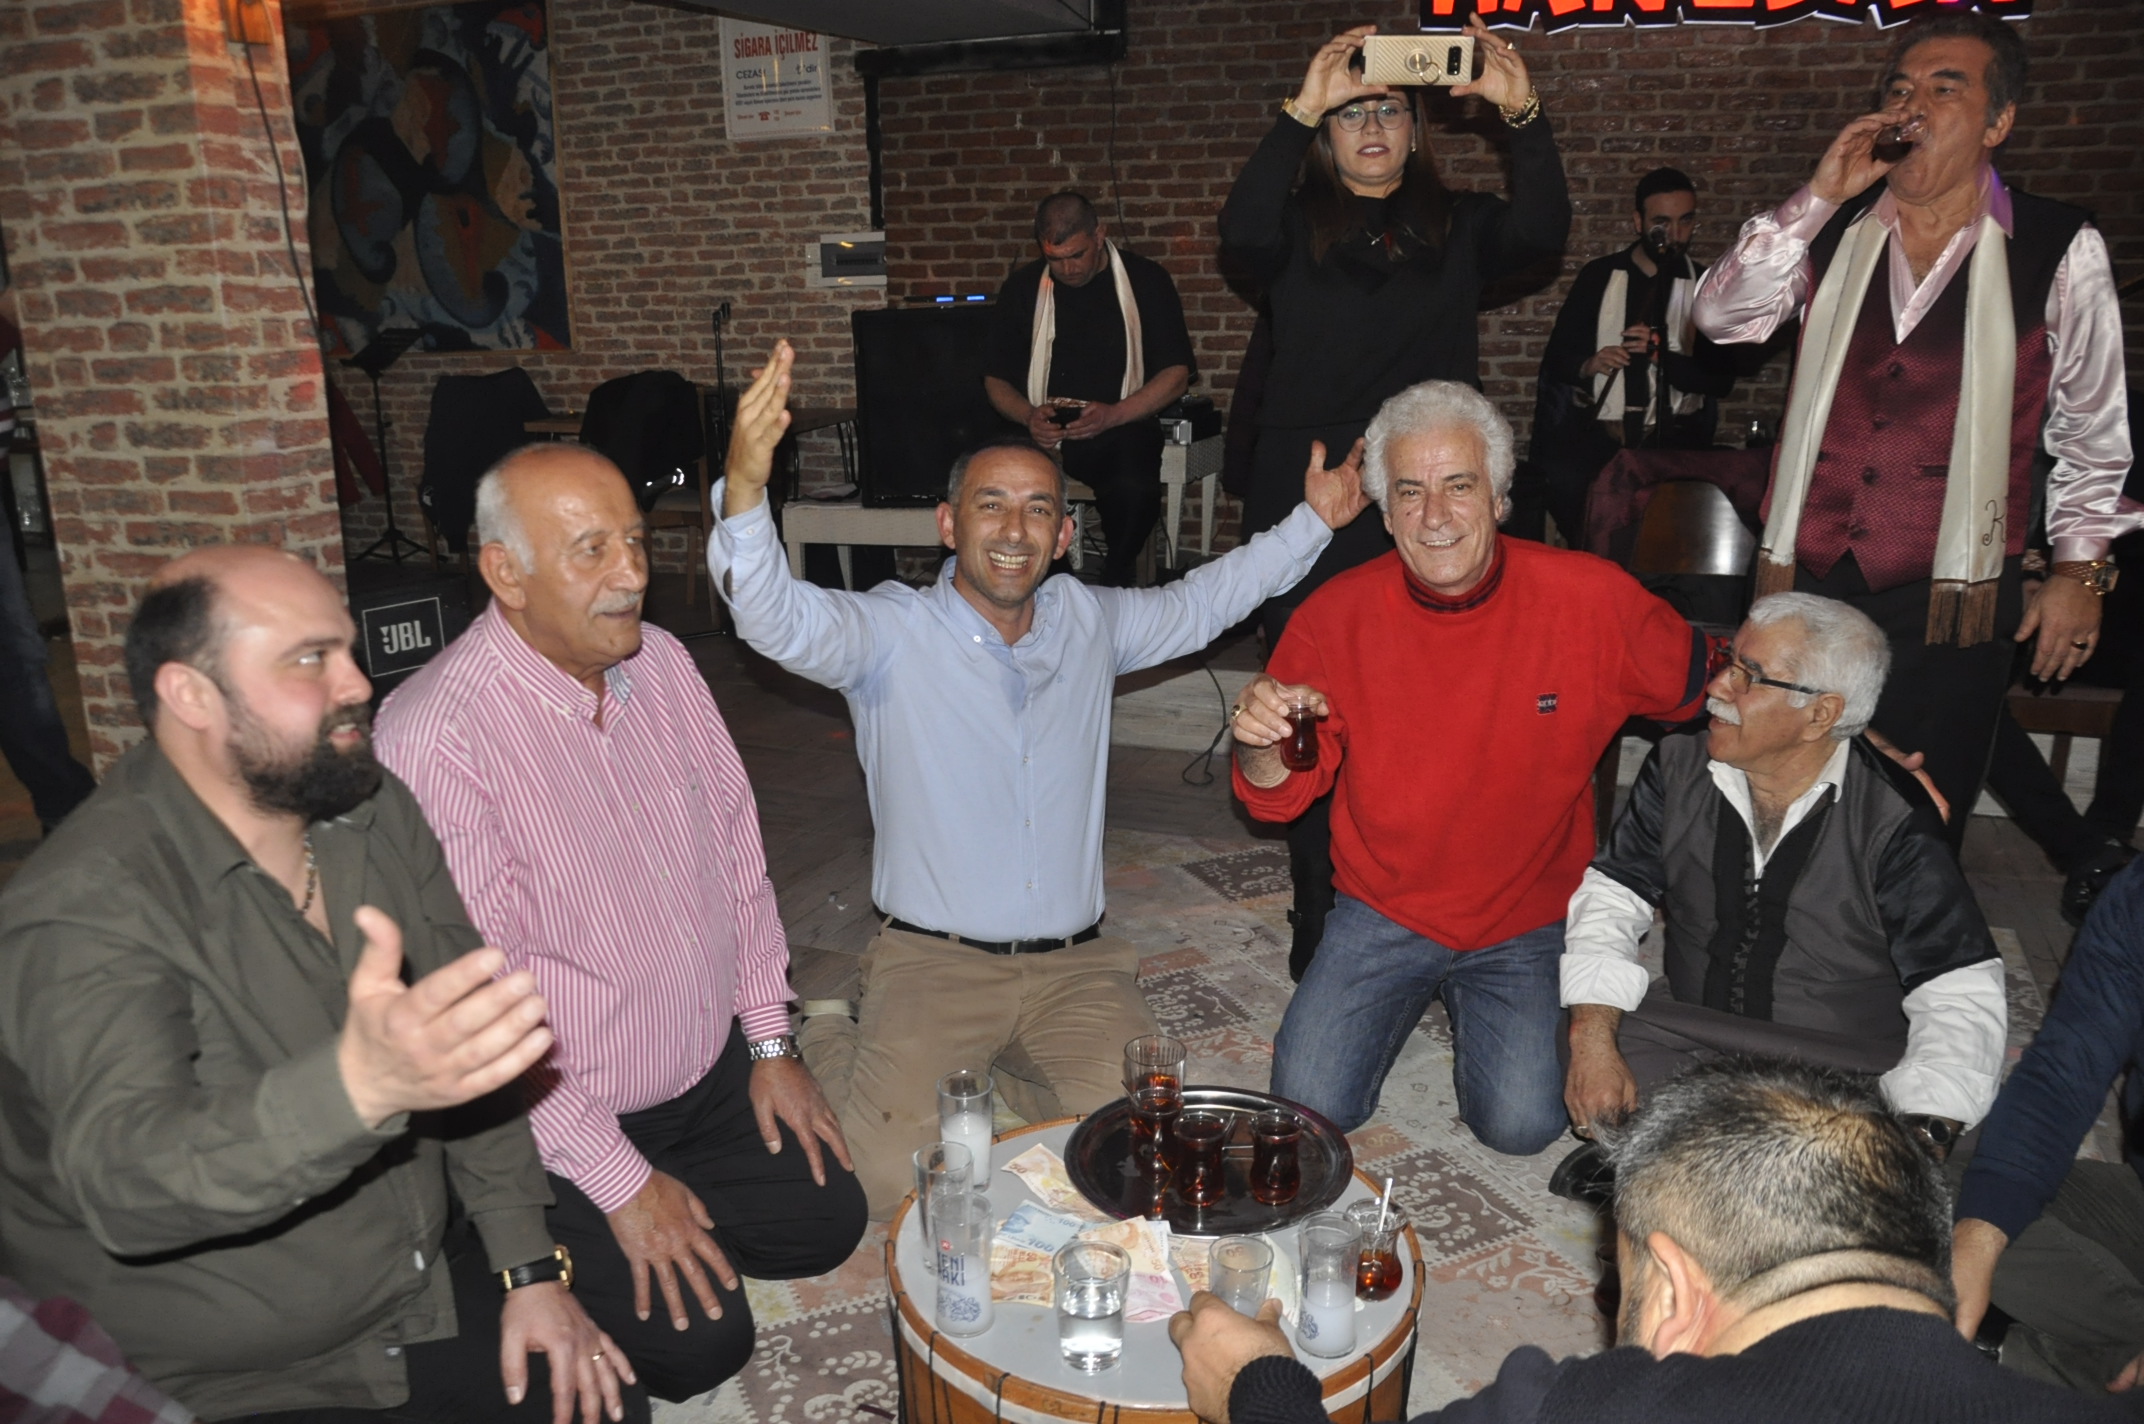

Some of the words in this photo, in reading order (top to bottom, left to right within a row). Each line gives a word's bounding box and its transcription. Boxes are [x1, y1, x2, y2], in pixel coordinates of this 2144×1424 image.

[734, 33, 772, 59] SİGARA
[774, 28, 818, 60] İÇİLMEZ
[382, 620, 431, 655] JBL
[1028, 1238, 1055, 1252] 100
[937, 1252, 965, 1271] ENİ
[938, 1268, 965, 1287] AKI
